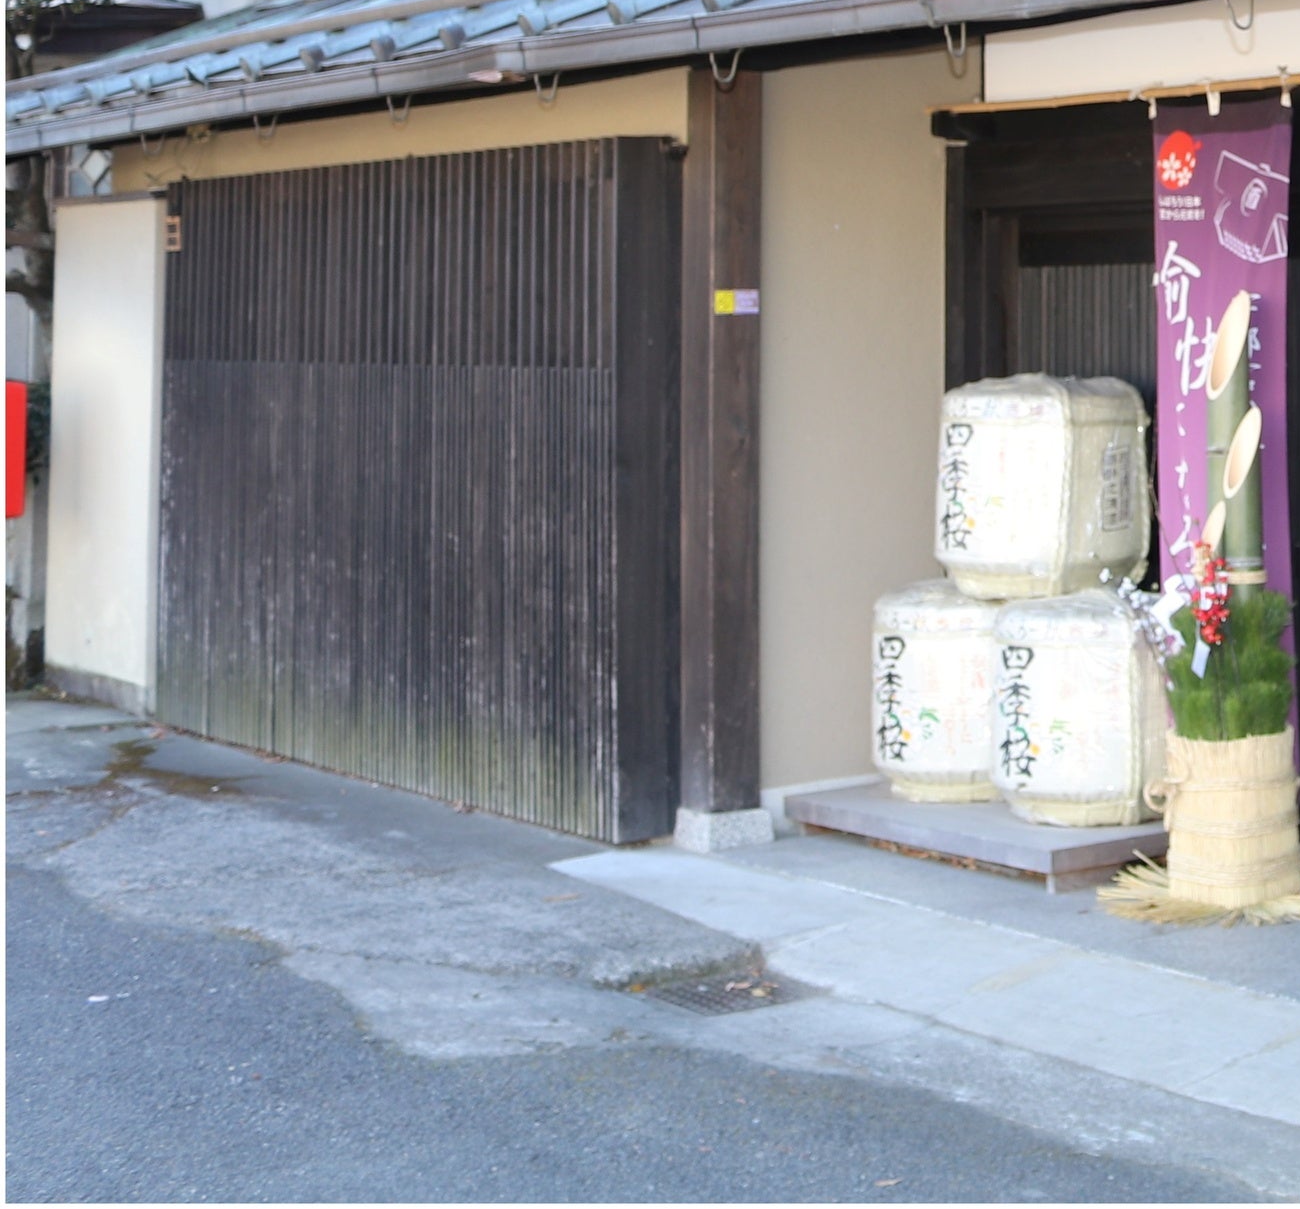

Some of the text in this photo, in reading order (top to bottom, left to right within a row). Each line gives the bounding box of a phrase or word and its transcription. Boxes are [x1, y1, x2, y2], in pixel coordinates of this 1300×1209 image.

[940, 422, 974, 551] 四季桜
[876, 635, 908, 762] 四季桜
[999, 644, 1037, 778] 四季桜
